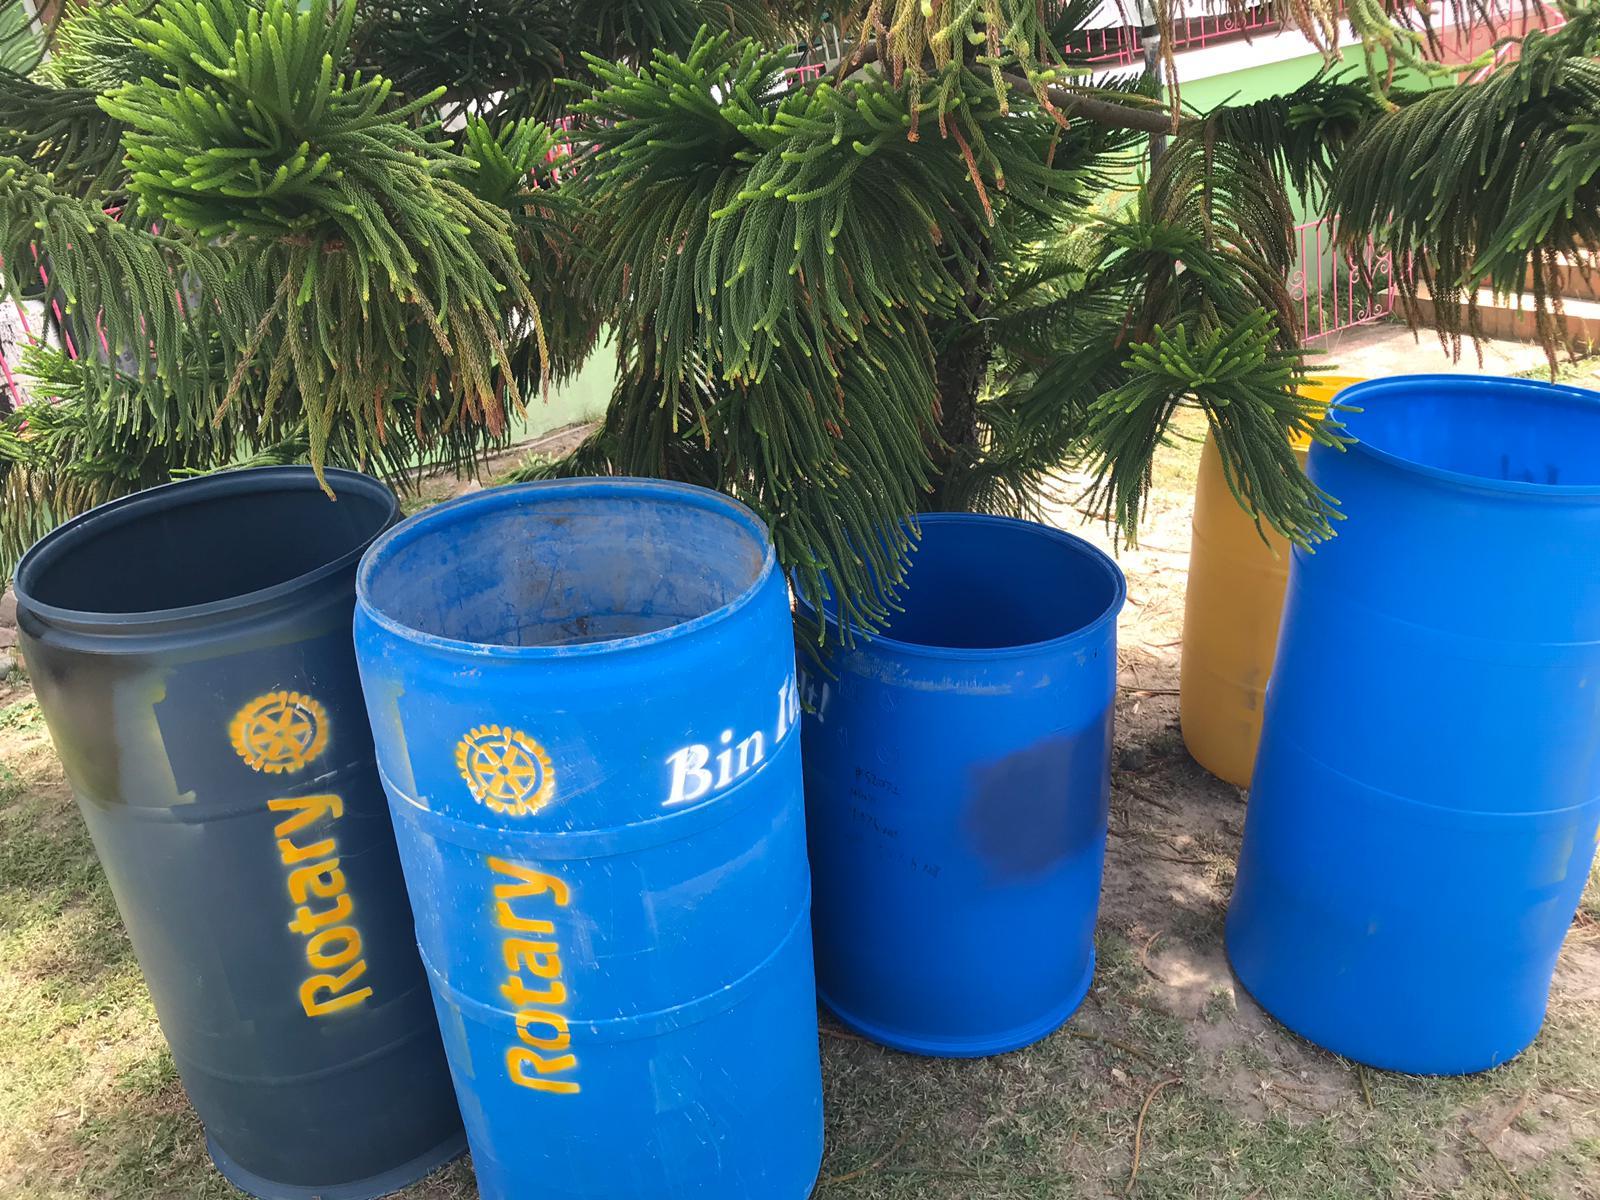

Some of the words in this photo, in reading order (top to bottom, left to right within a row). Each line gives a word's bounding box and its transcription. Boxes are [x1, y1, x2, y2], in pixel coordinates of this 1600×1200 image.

[661, 729, 764, 806] Bin
[267, 794, 373, 1018] Rotary
[487, 856, 581, 1095] Rotary
